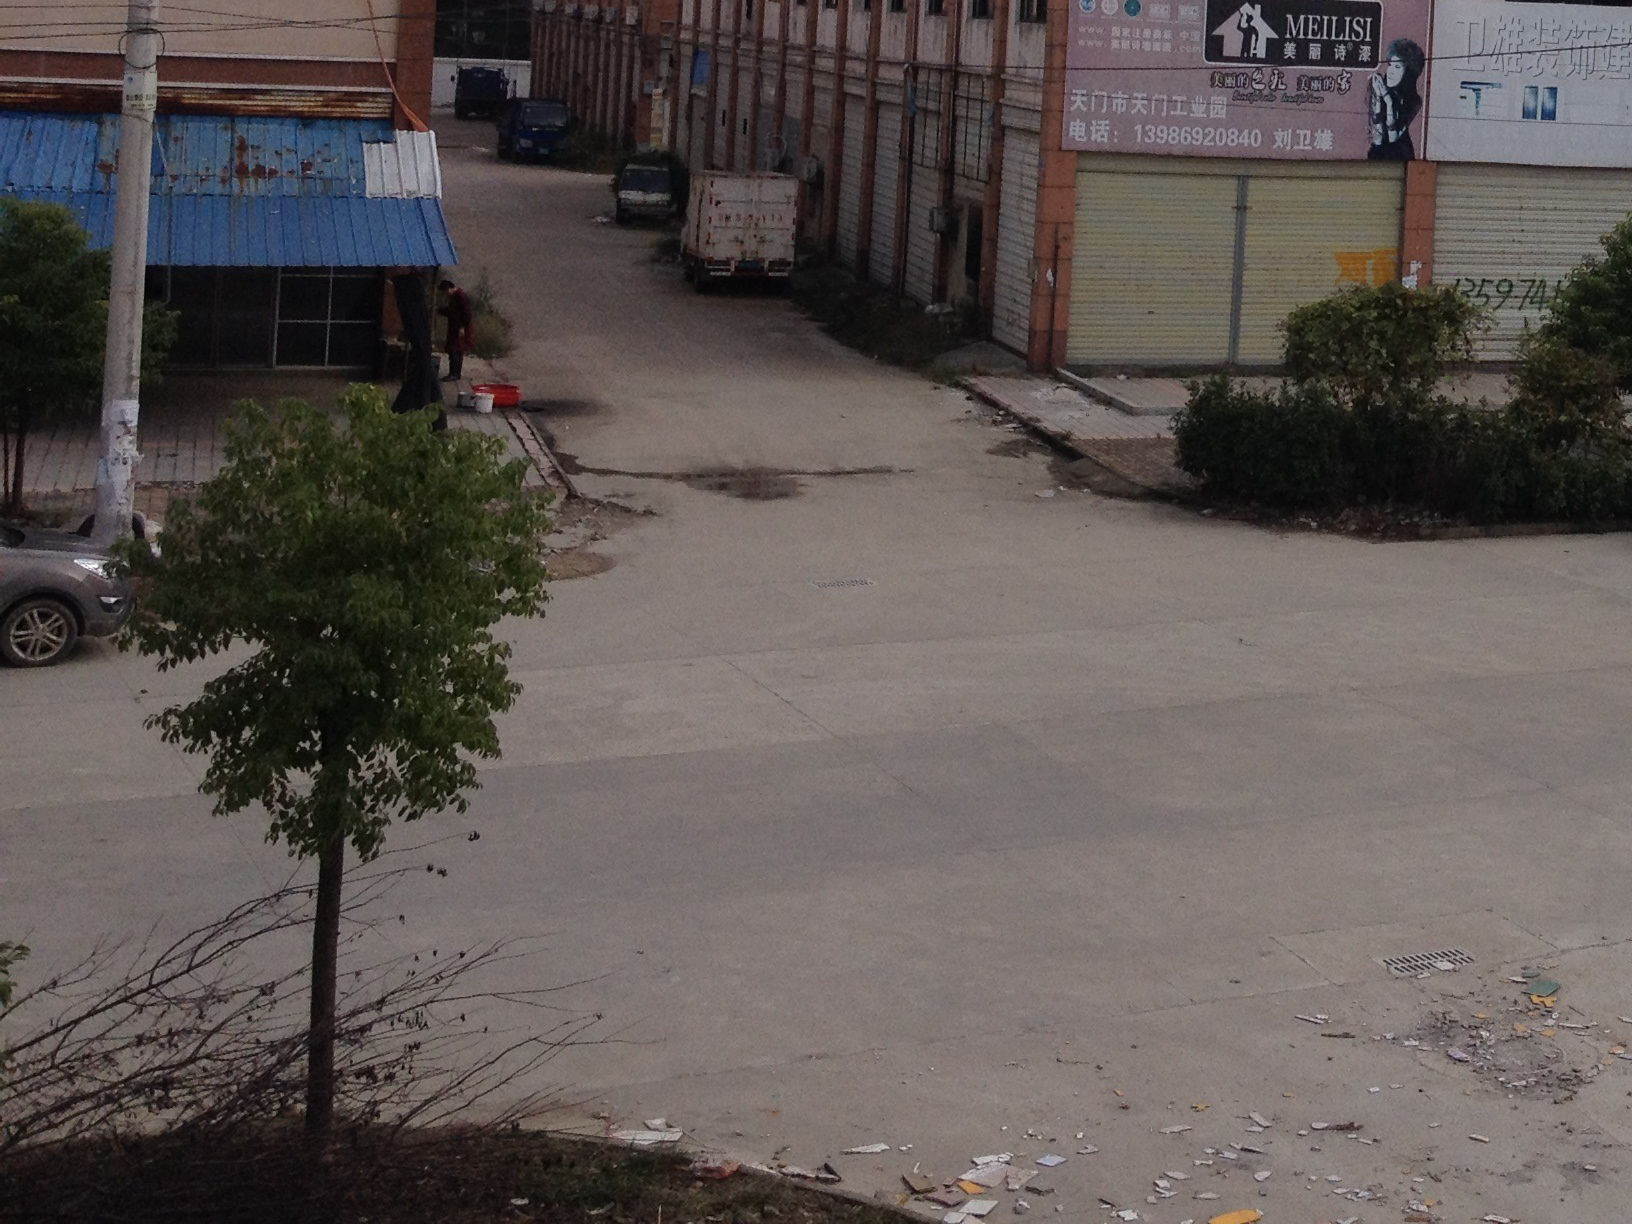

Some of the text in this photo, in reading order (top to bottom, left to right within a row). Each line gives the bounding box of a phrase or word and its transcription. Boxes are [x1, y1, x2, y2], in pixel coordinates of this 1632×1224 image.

[1284, 14, 1373, 42] MEILISI
[1069, 88, 1229, 120] 天门市天门工业园
[1133, 122, 1263, 149] 13986920840
